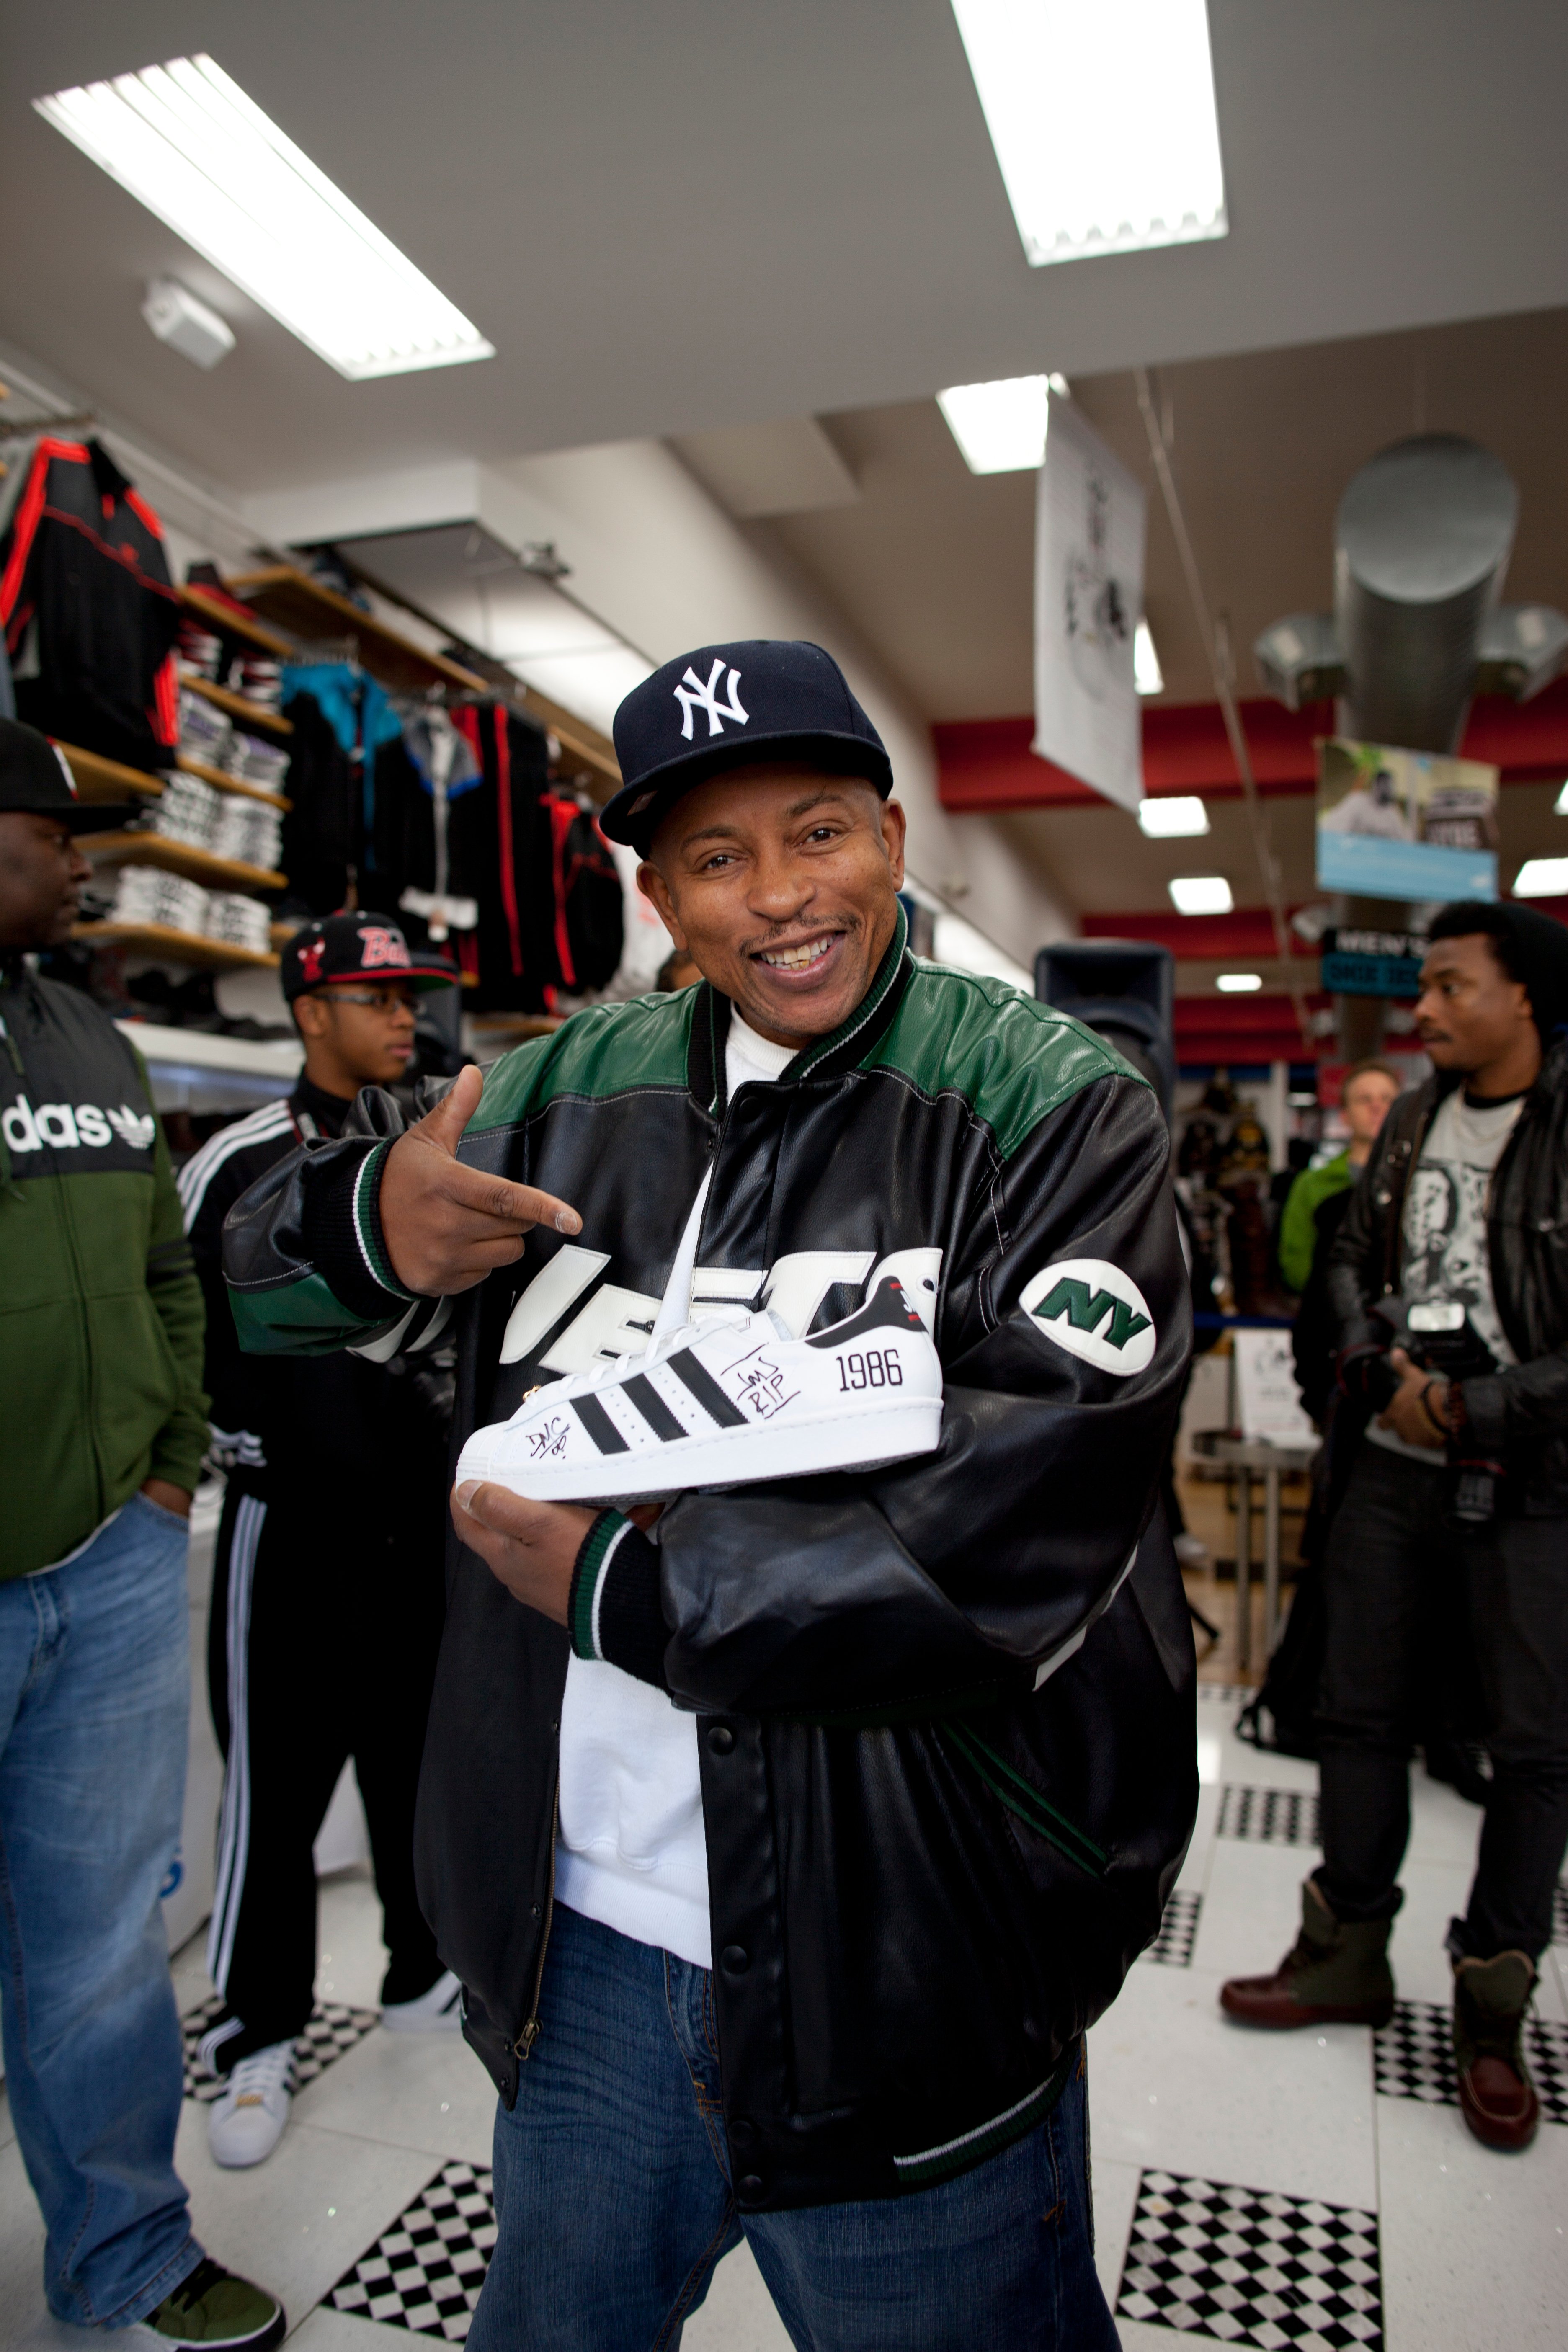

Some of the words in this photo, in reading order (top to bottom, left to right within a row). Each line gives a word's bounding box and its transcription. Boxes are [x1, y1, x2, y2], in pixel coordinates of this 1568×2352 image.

[673, 658, 750, 741] NY
[1031, 1277, 1153, 1351] NY
[836, 1349, 903, 1391] 1986
